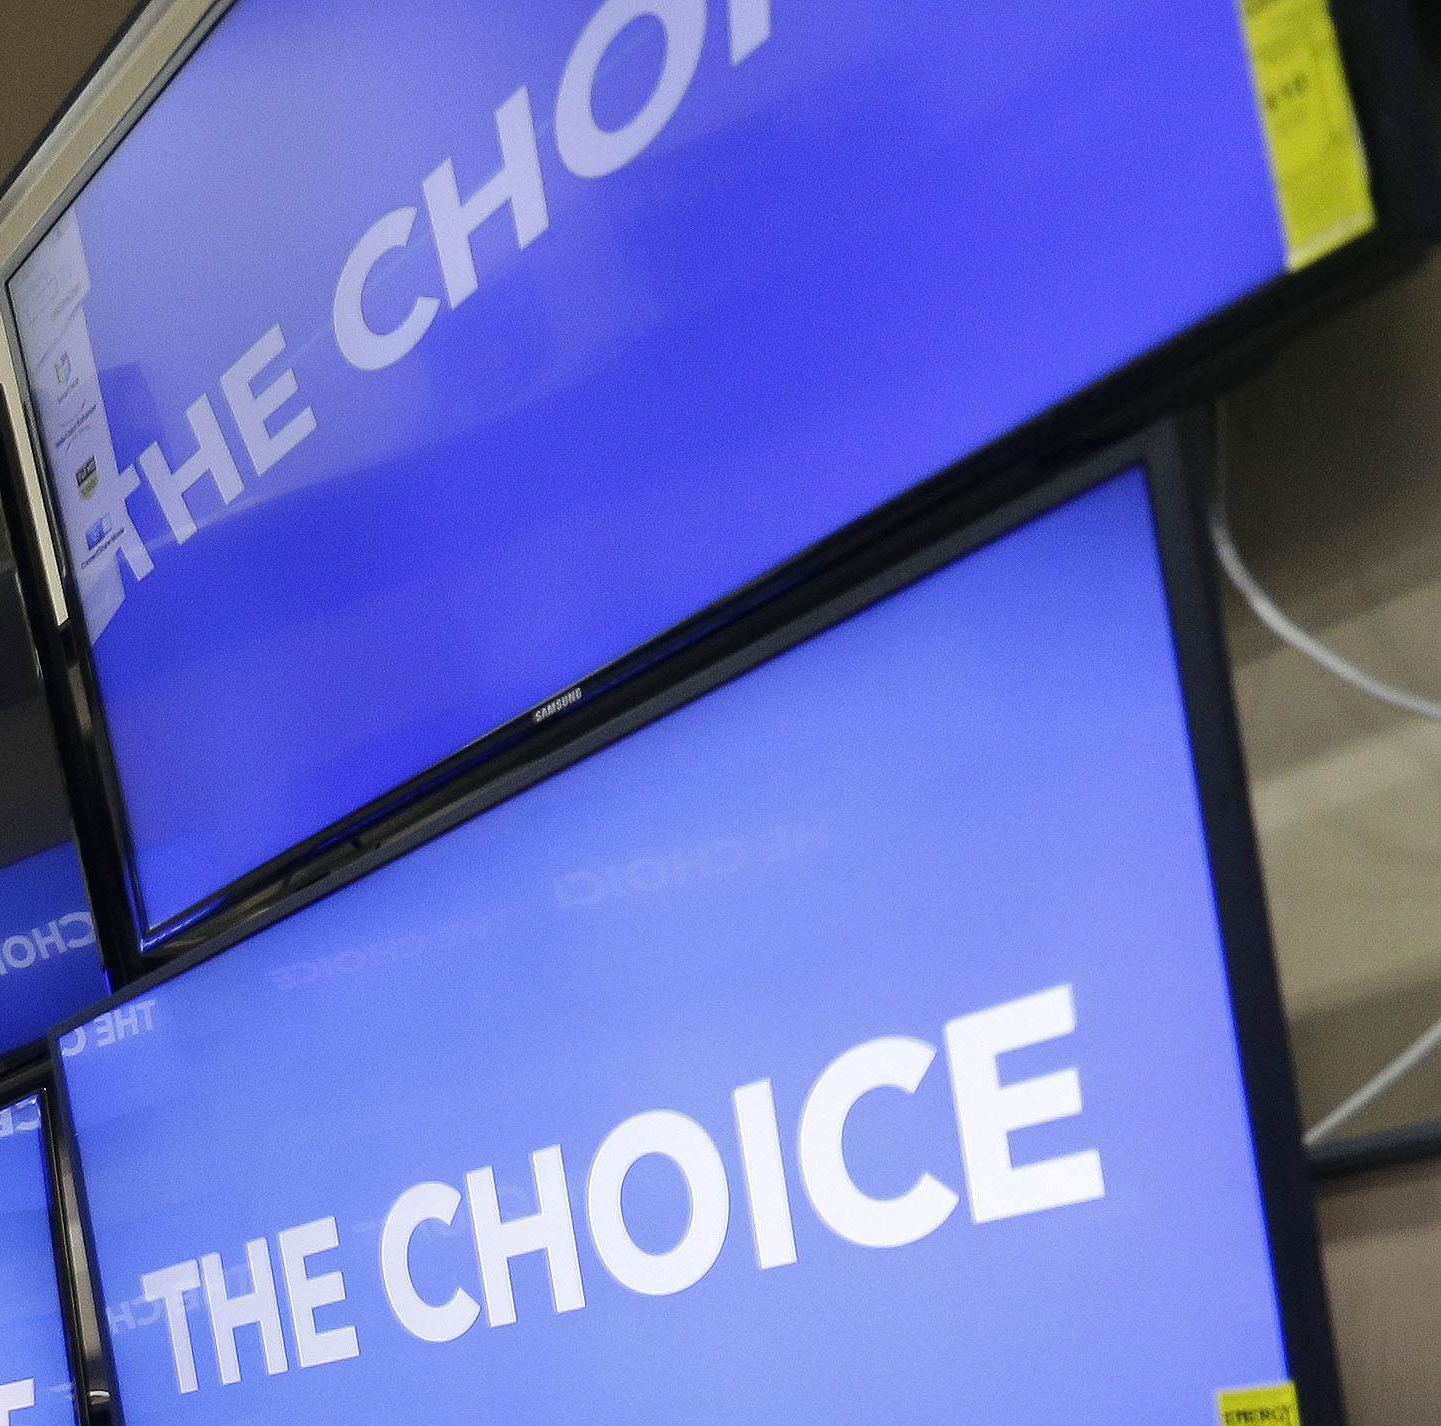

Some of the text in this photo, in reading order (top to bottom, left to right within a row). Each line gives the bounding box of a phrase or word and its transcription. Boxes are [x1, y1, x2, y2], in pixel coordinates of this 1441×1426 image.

[115, 324, 318, 582] THE
[534, 687, 584, 723] SAMSUNG
[144, 983, 1105, 1394] THE CHOICE
